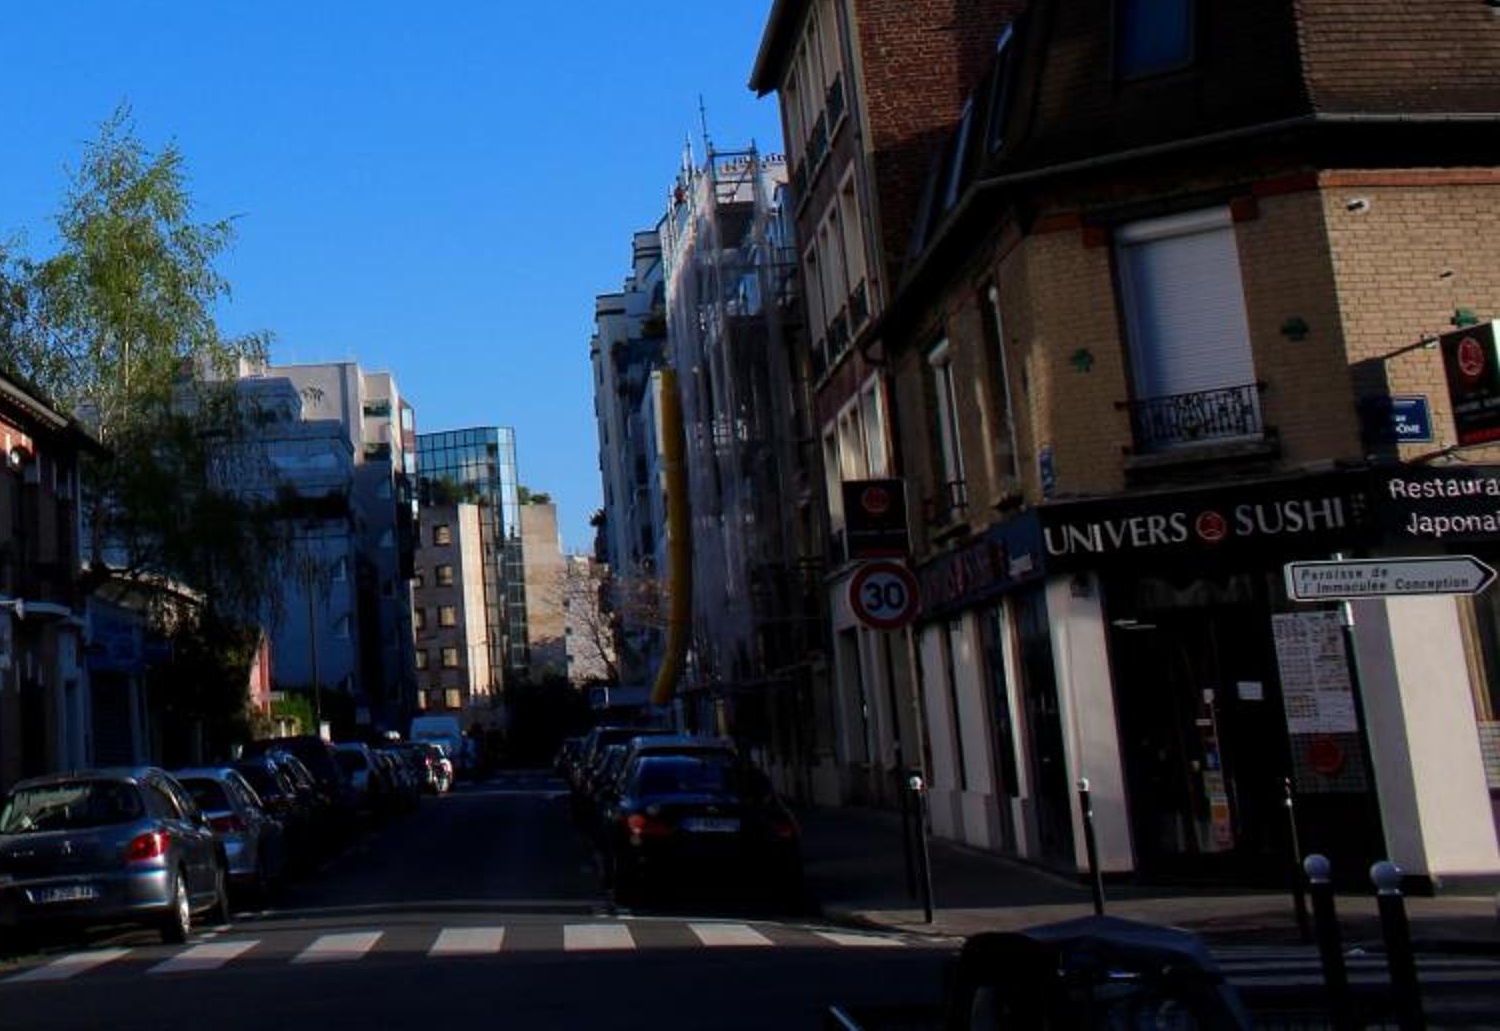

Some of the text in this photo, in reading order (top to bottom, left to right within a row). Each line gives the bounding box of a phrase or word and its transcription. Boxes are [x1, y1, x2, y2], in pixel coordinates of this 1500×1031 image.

[1043, 512, 1189, 556] UNIVERS
[1235, 496, 1347, 537] SUSHI
[1301, 567, 1388, 581] Paroisse de
[1394, 574, 1470, 593] Conception
[866, 581, 905, 611] 30
